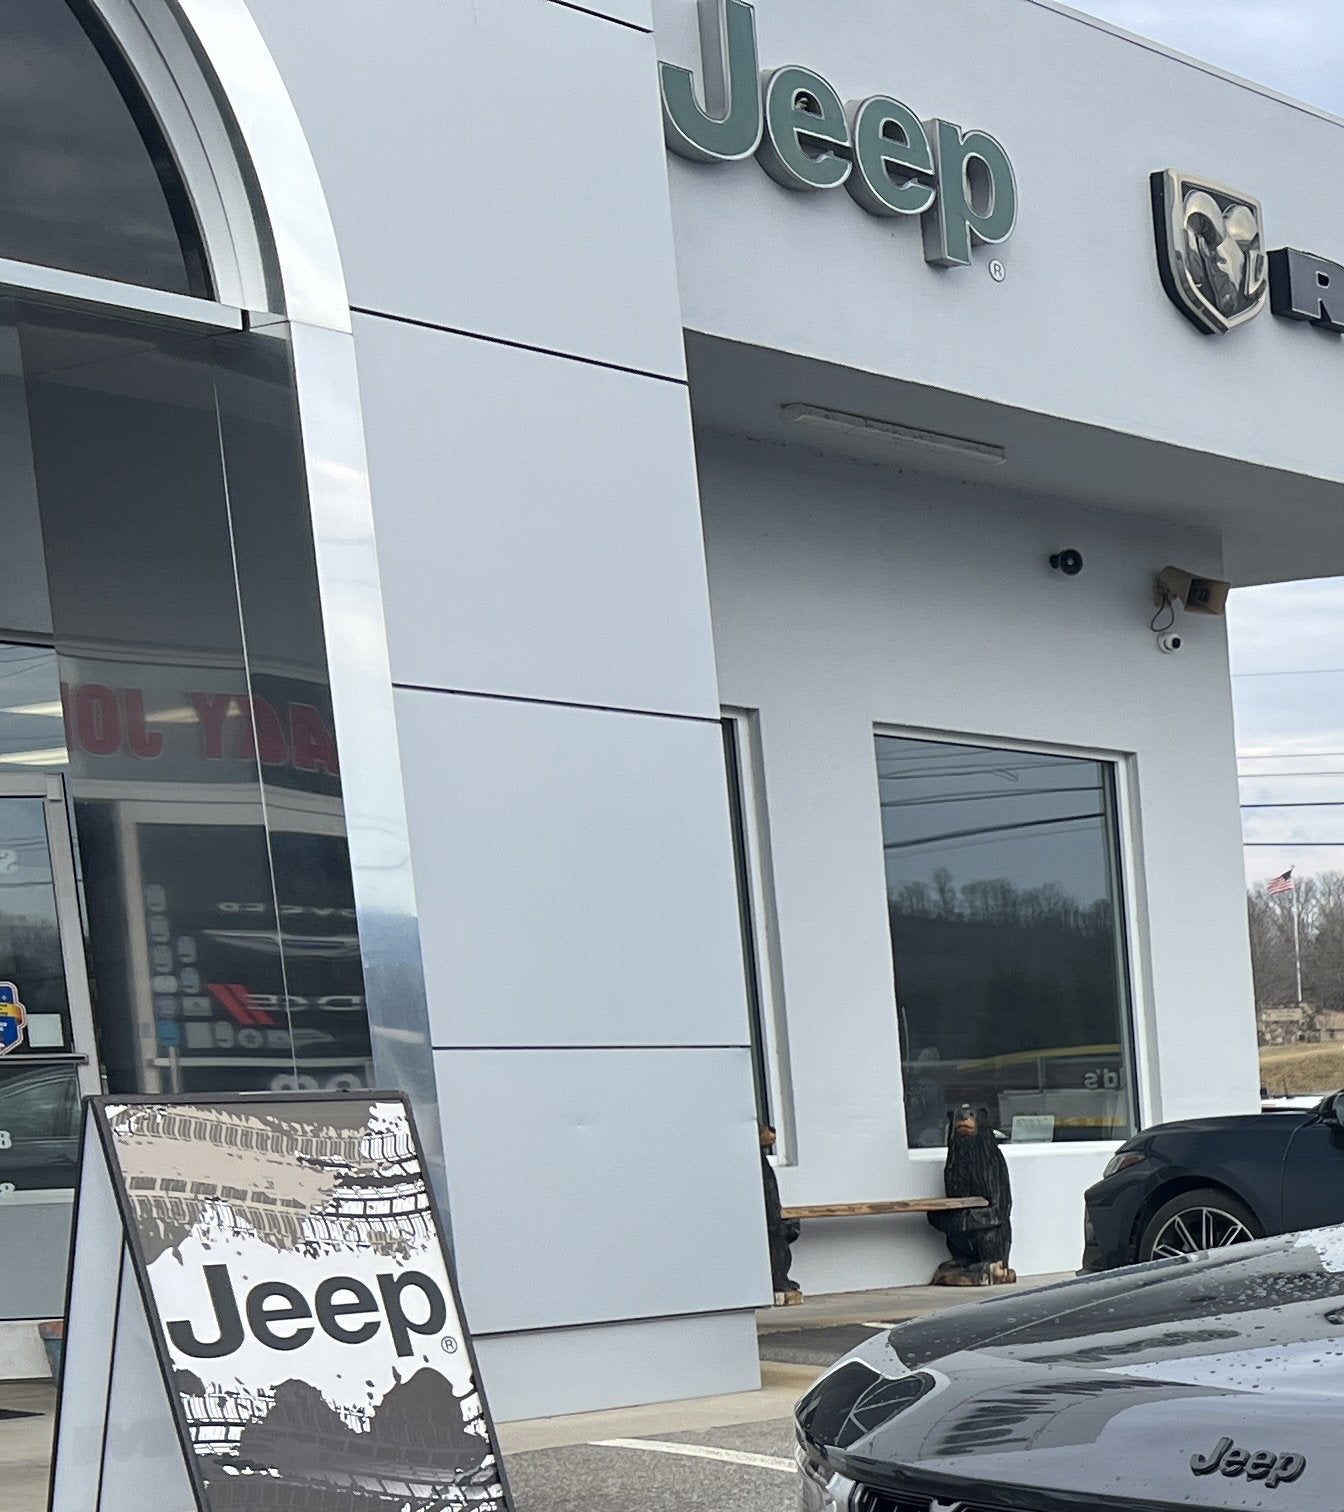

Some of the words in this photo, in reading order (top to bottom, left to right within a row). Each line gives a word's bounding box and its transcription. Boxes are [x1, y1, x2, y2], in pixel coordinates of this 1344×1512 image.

[658, 0, 1018, 268] Jeep
[166, 1264, 447, 1359] Jeep
[1190, 1437, 1307, 1489] Jeep
